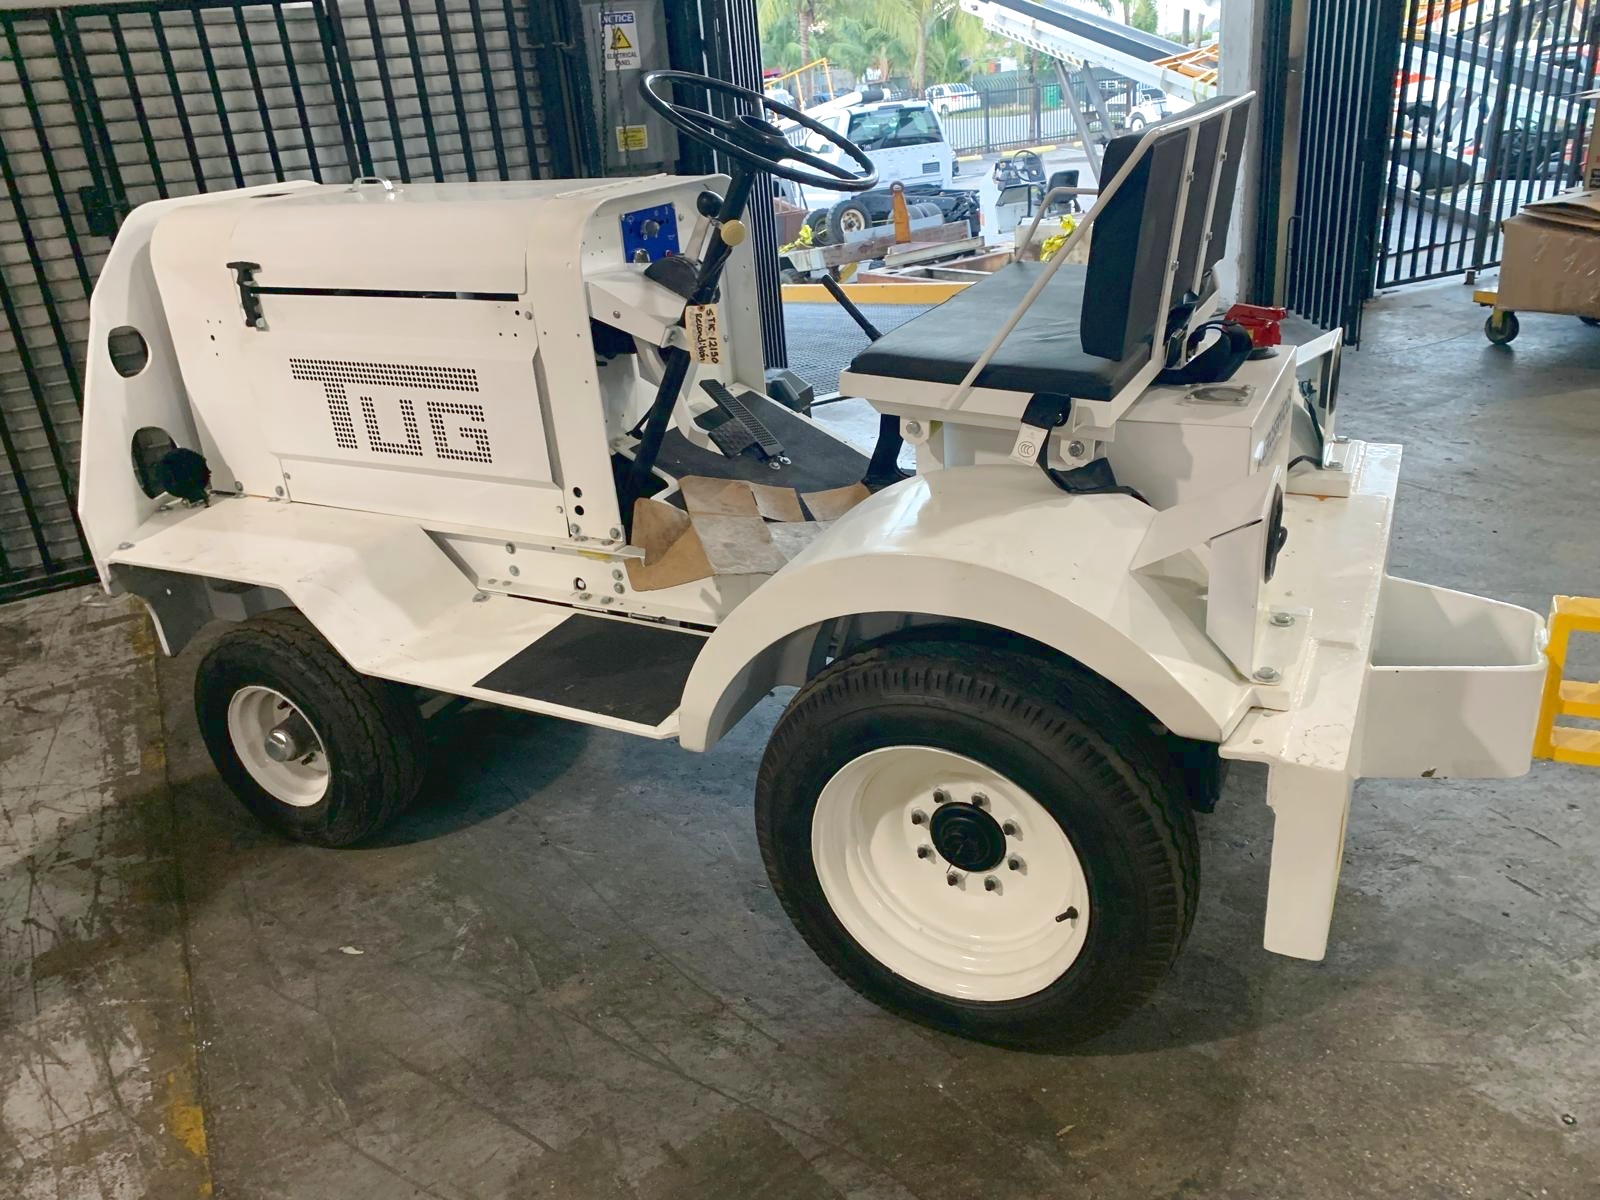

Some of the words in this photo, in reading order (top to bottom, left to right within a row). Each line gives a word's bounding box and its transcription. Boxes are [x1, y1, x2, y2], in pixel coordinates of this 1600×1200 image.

[603, 13, 633, 23] NOTICE
[706, 308, 716, 331] STK
[708, 337, 719, 364] 12150
[289, 358, 493, 464] TUG
